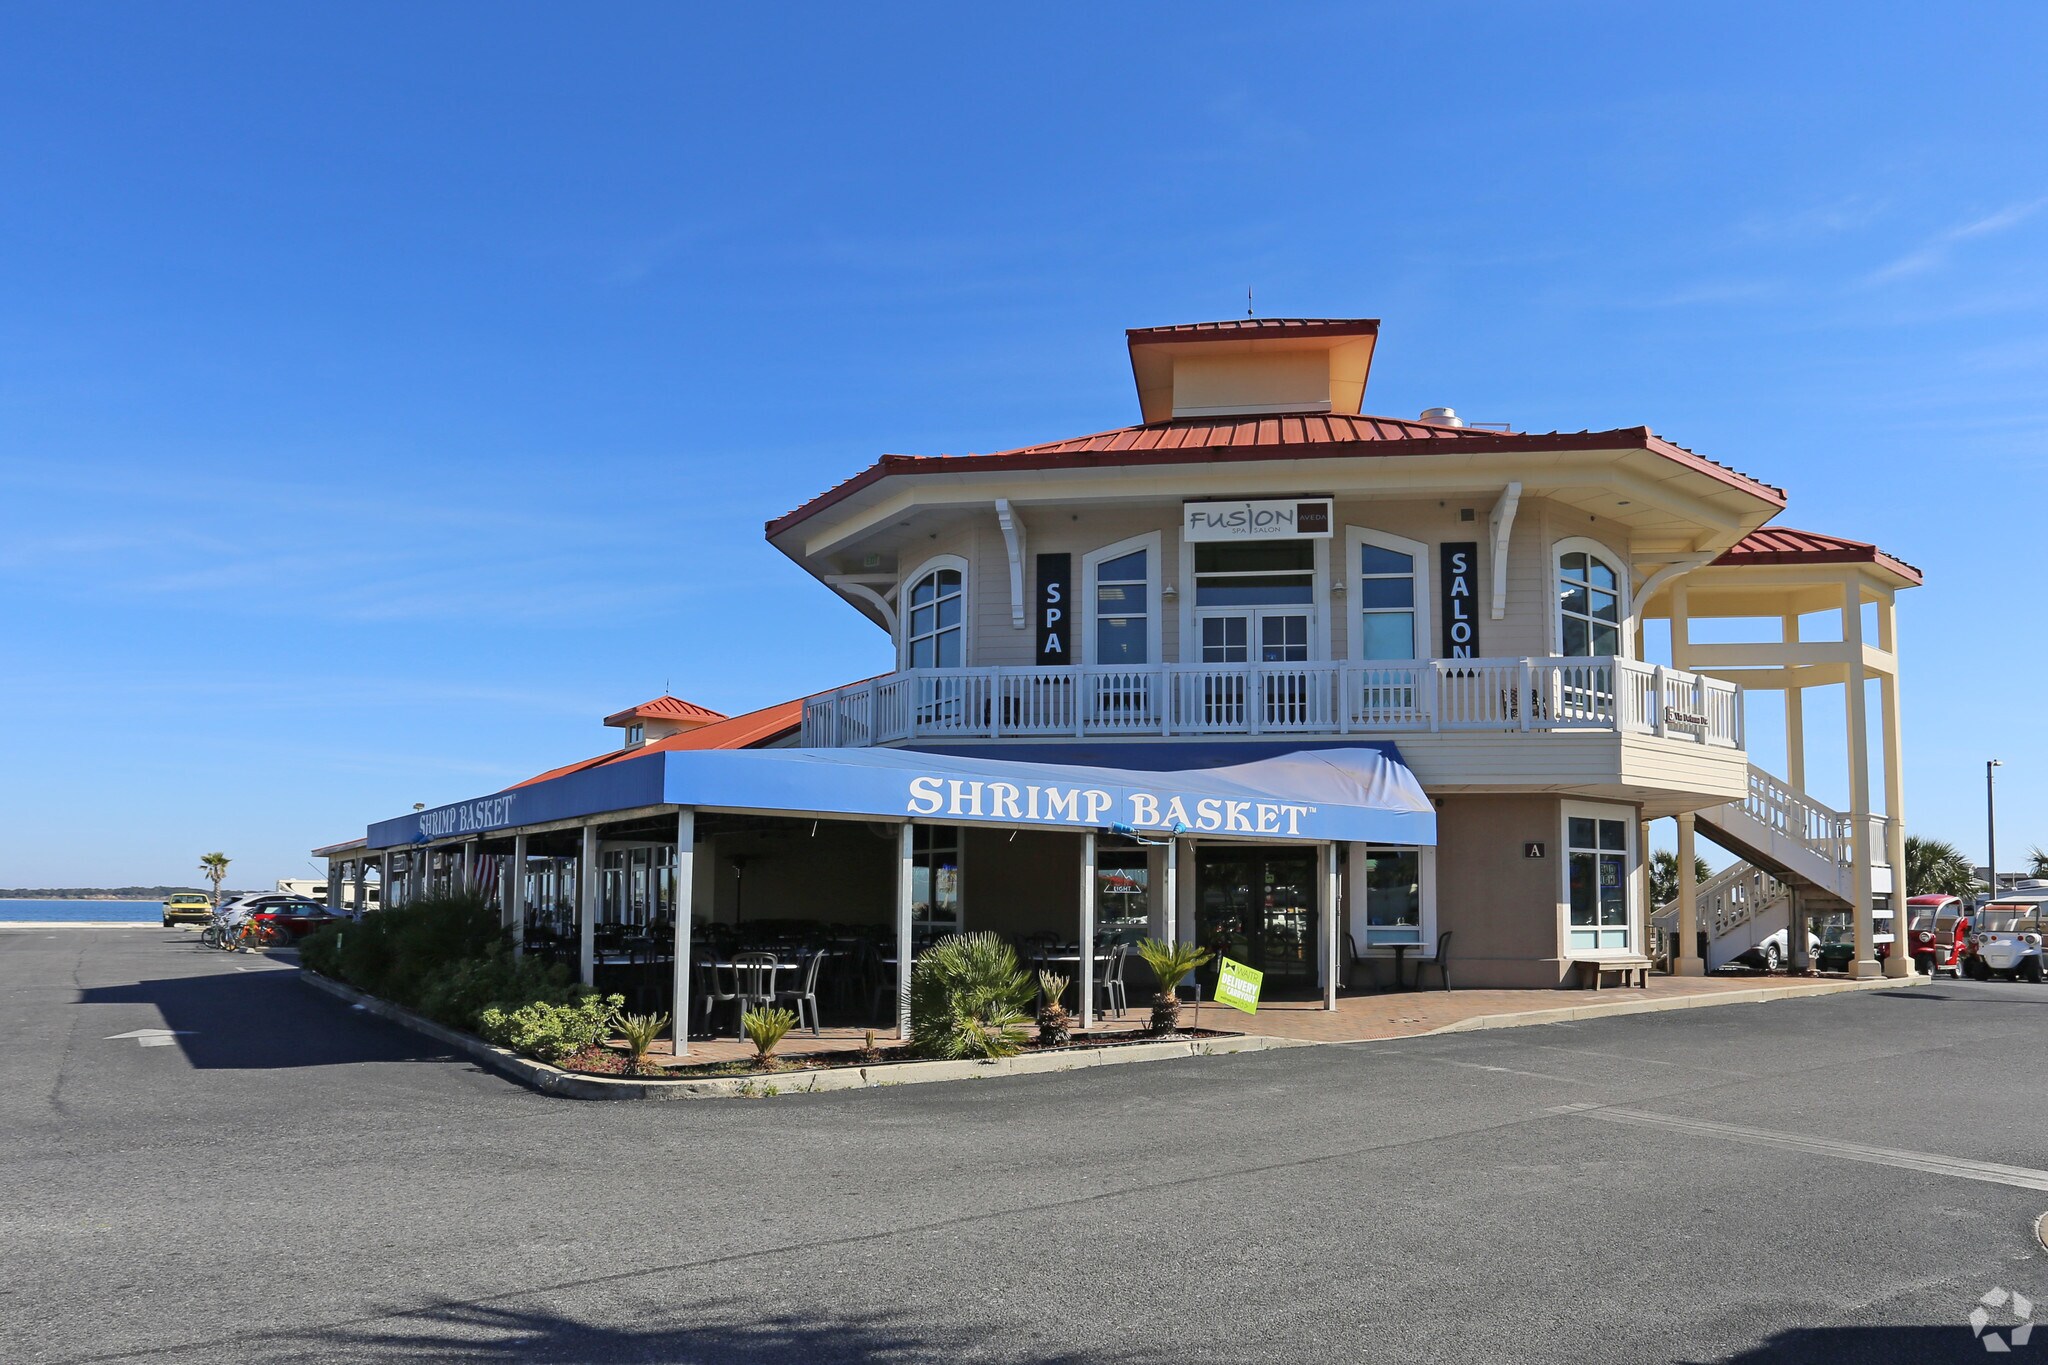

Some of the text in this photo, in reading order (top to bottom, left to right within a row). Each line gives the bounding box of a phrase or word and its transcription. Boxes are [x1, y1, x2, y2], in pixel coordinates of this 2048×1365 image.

[1254, 526, 1281, 534] SALON
[1044, 582, 1062, 653] SPA
[1450, 552, 1471, 659] SALON
[419, 795, 513, 836] SHRIMP BASKET
[907, 776, 1113, 823] SHRIMP
[1128, 793, 1308, 835] BASKET
[1530, 844, 1541, 857] A
[1113, 885, 1132, 893] LIGHT
[1221, 972, 1259, 996] DELIVERY
